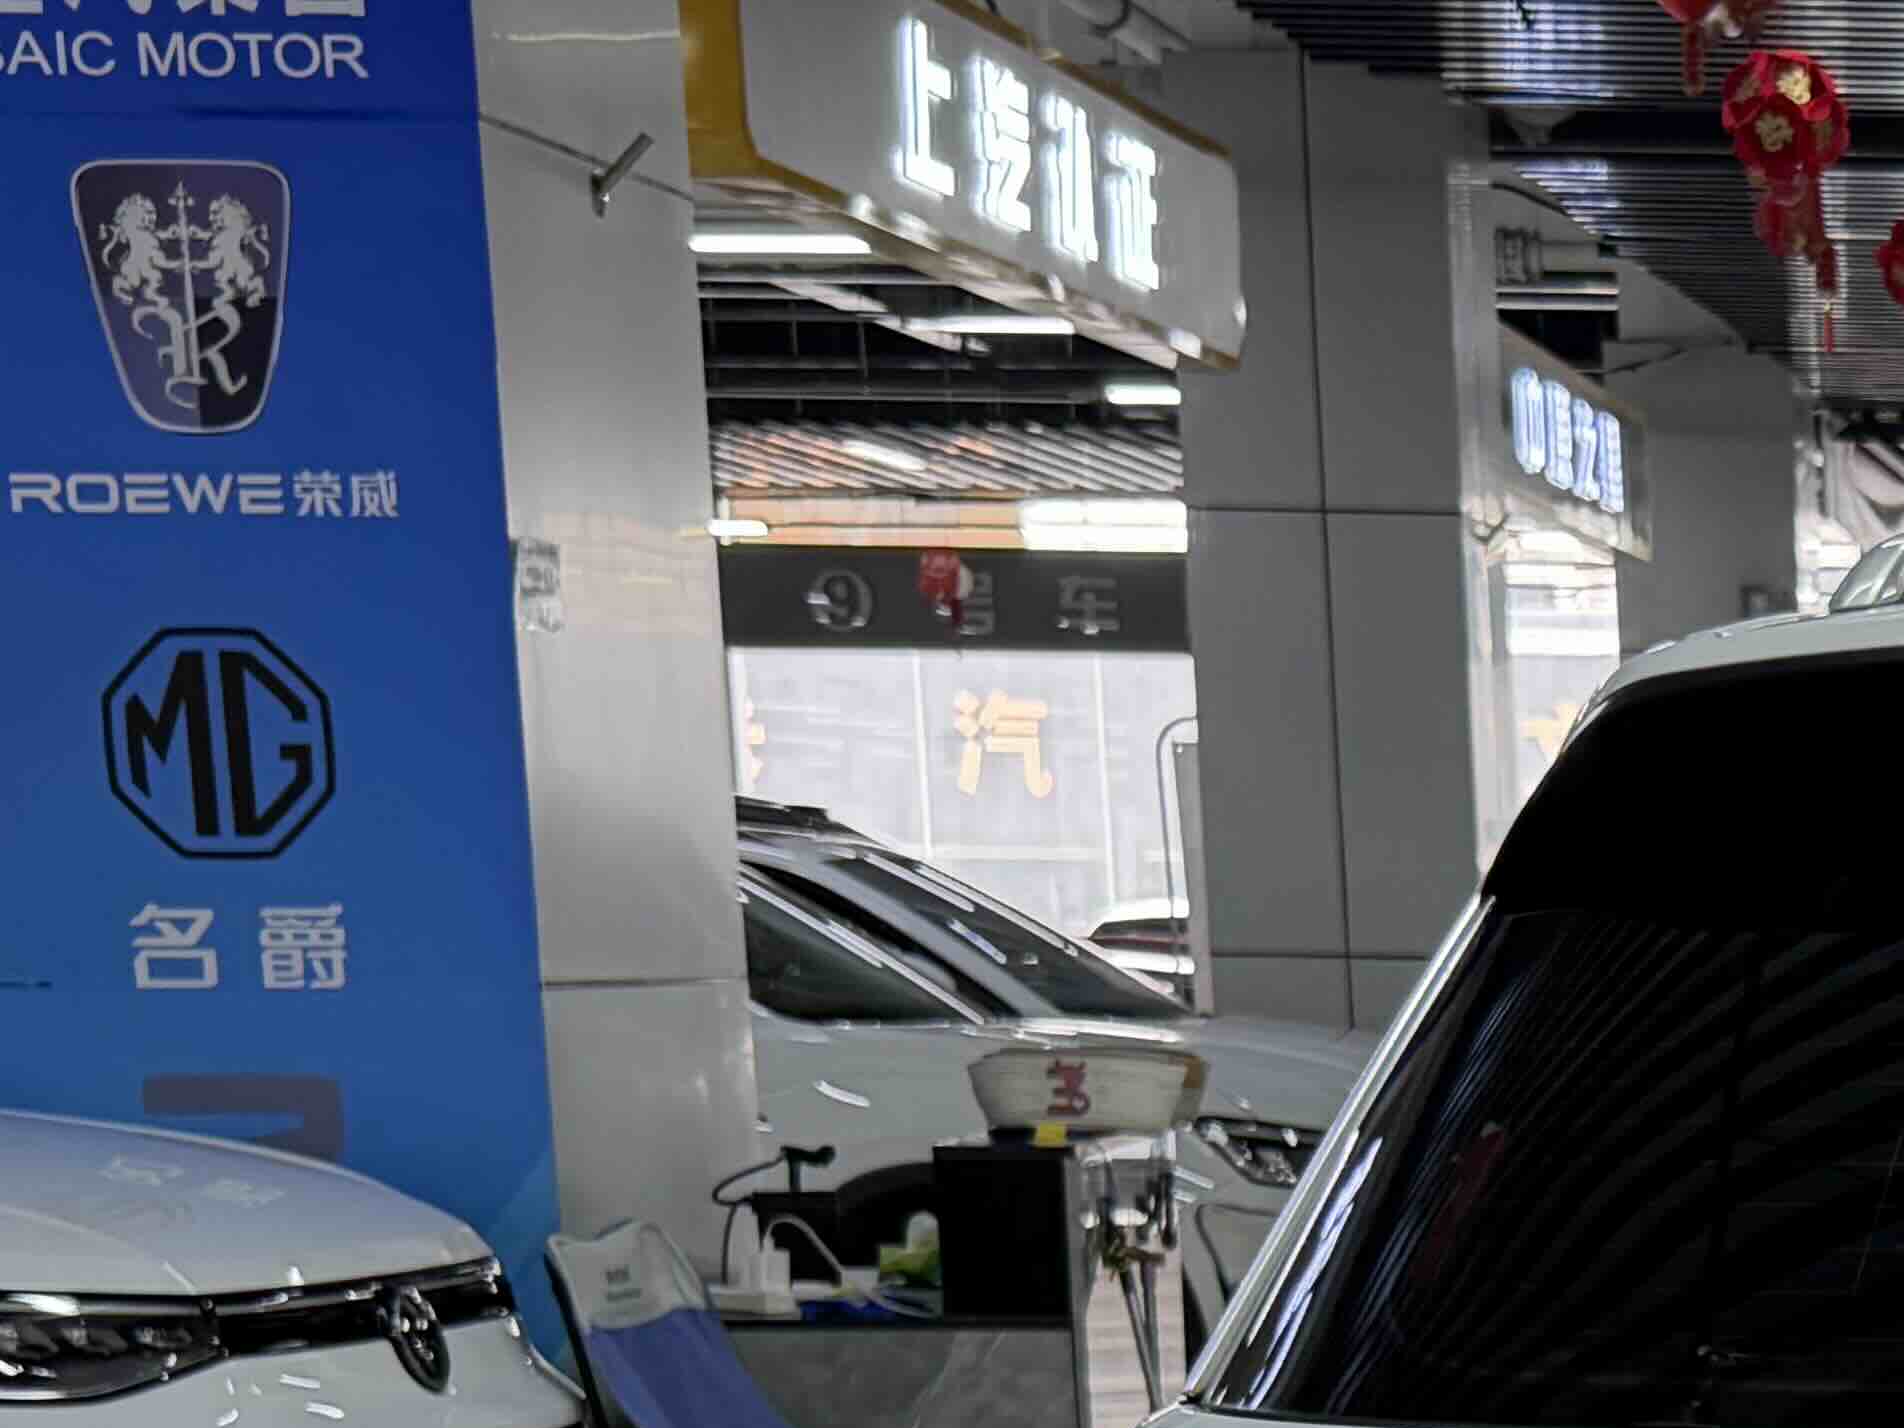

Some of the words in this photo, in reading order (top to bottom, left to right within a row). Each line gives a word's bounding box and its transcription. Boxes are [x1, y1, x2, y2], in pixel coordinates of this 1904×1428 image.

[0, 30, 116, 77] AIC
[136, 31, 369, 78] MOTOR
[890, 14, 1160, 292] 上汽认证
[9, 474, 285, 516] ROEWE
[293, 469, 400, 518] 荣威
[124, 650, 312, 837] MG
[129, 903, 346, 990] 名爵
